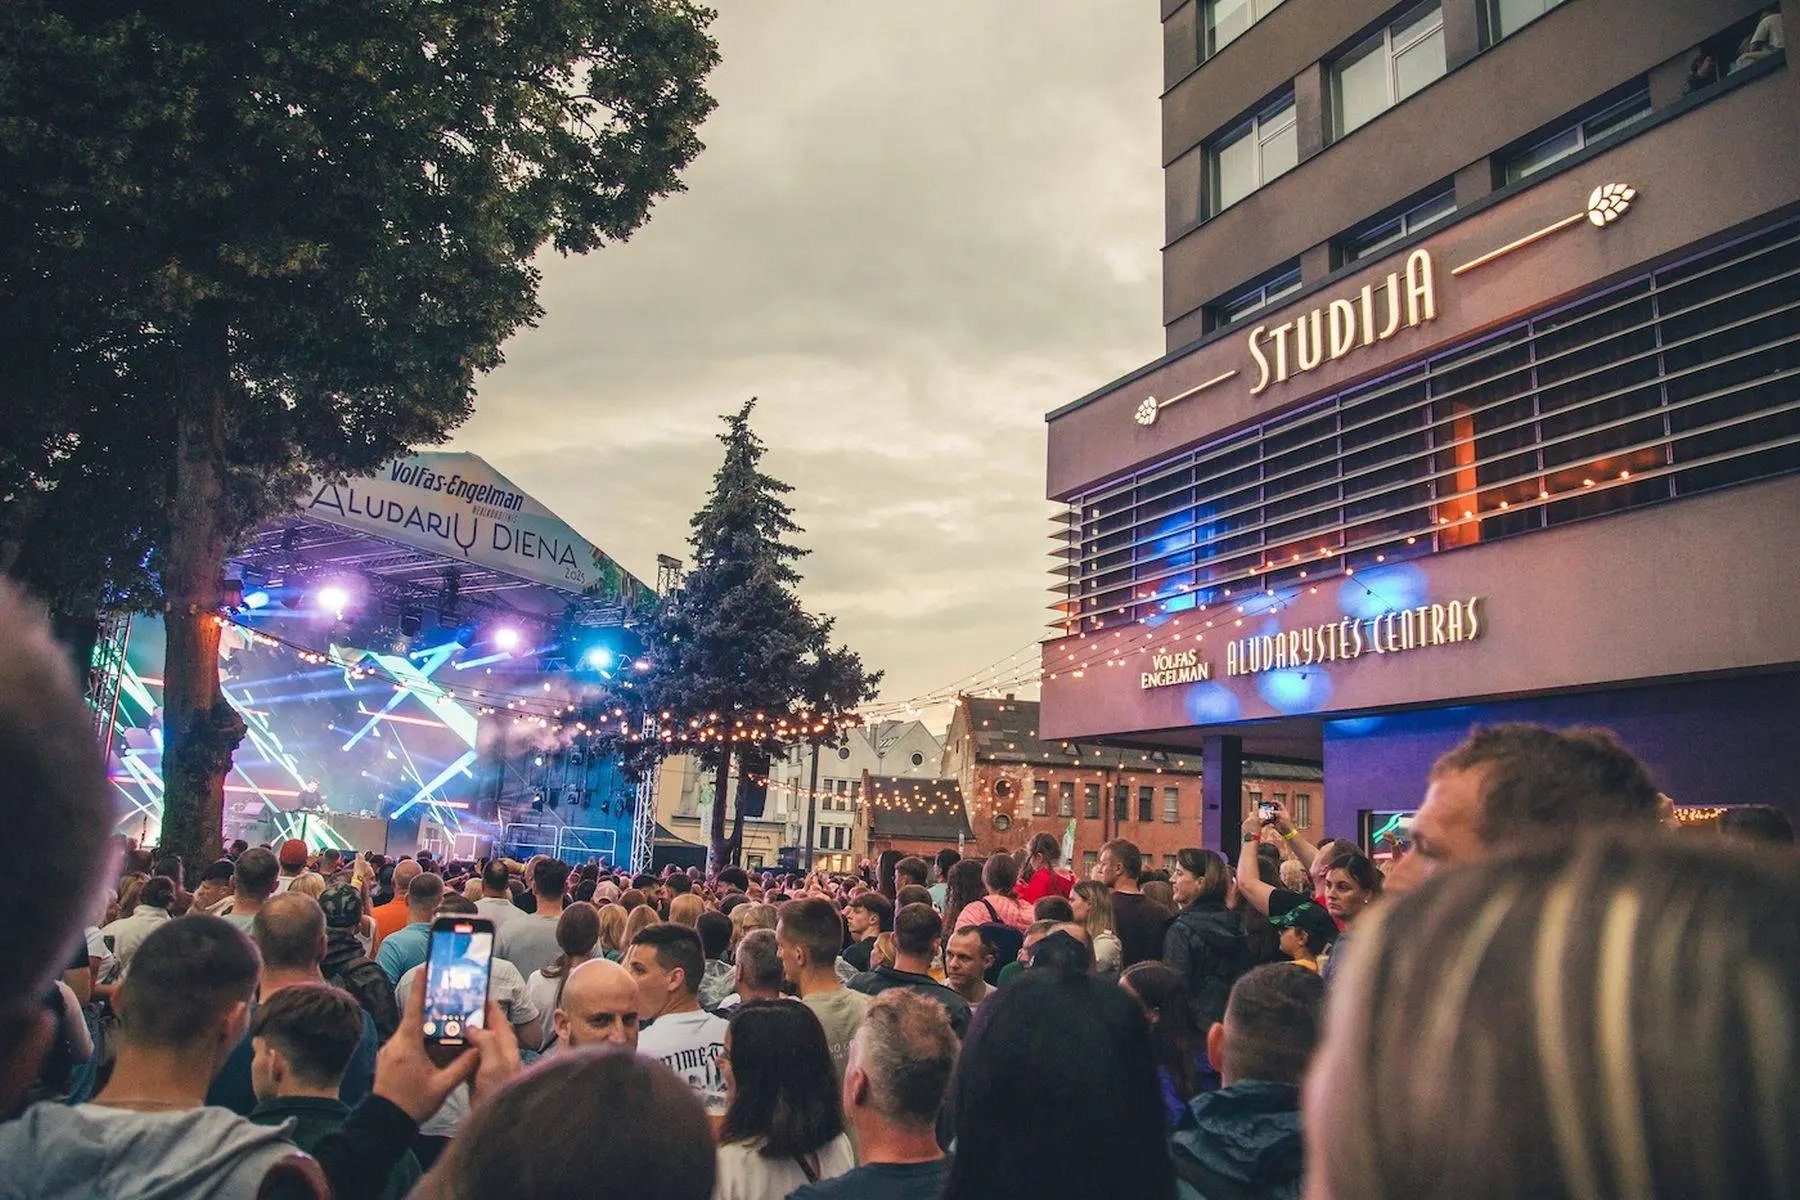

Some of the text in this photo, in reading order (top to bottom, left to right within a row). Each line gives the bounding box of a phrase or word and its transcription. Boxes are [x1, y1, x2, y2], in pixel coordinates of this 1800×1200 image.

[1248, 248, 1436, 395] STUDIJA
[308, 483, 578, 569] ALUDARIŲ DIENA
[1141, 662, 1209, 689] ENGELMAN
[1152, 648, 1197, 671] VOLFAS
[1227, 596, 1478, 676] ALUDARYSTĖS CENTRAS
